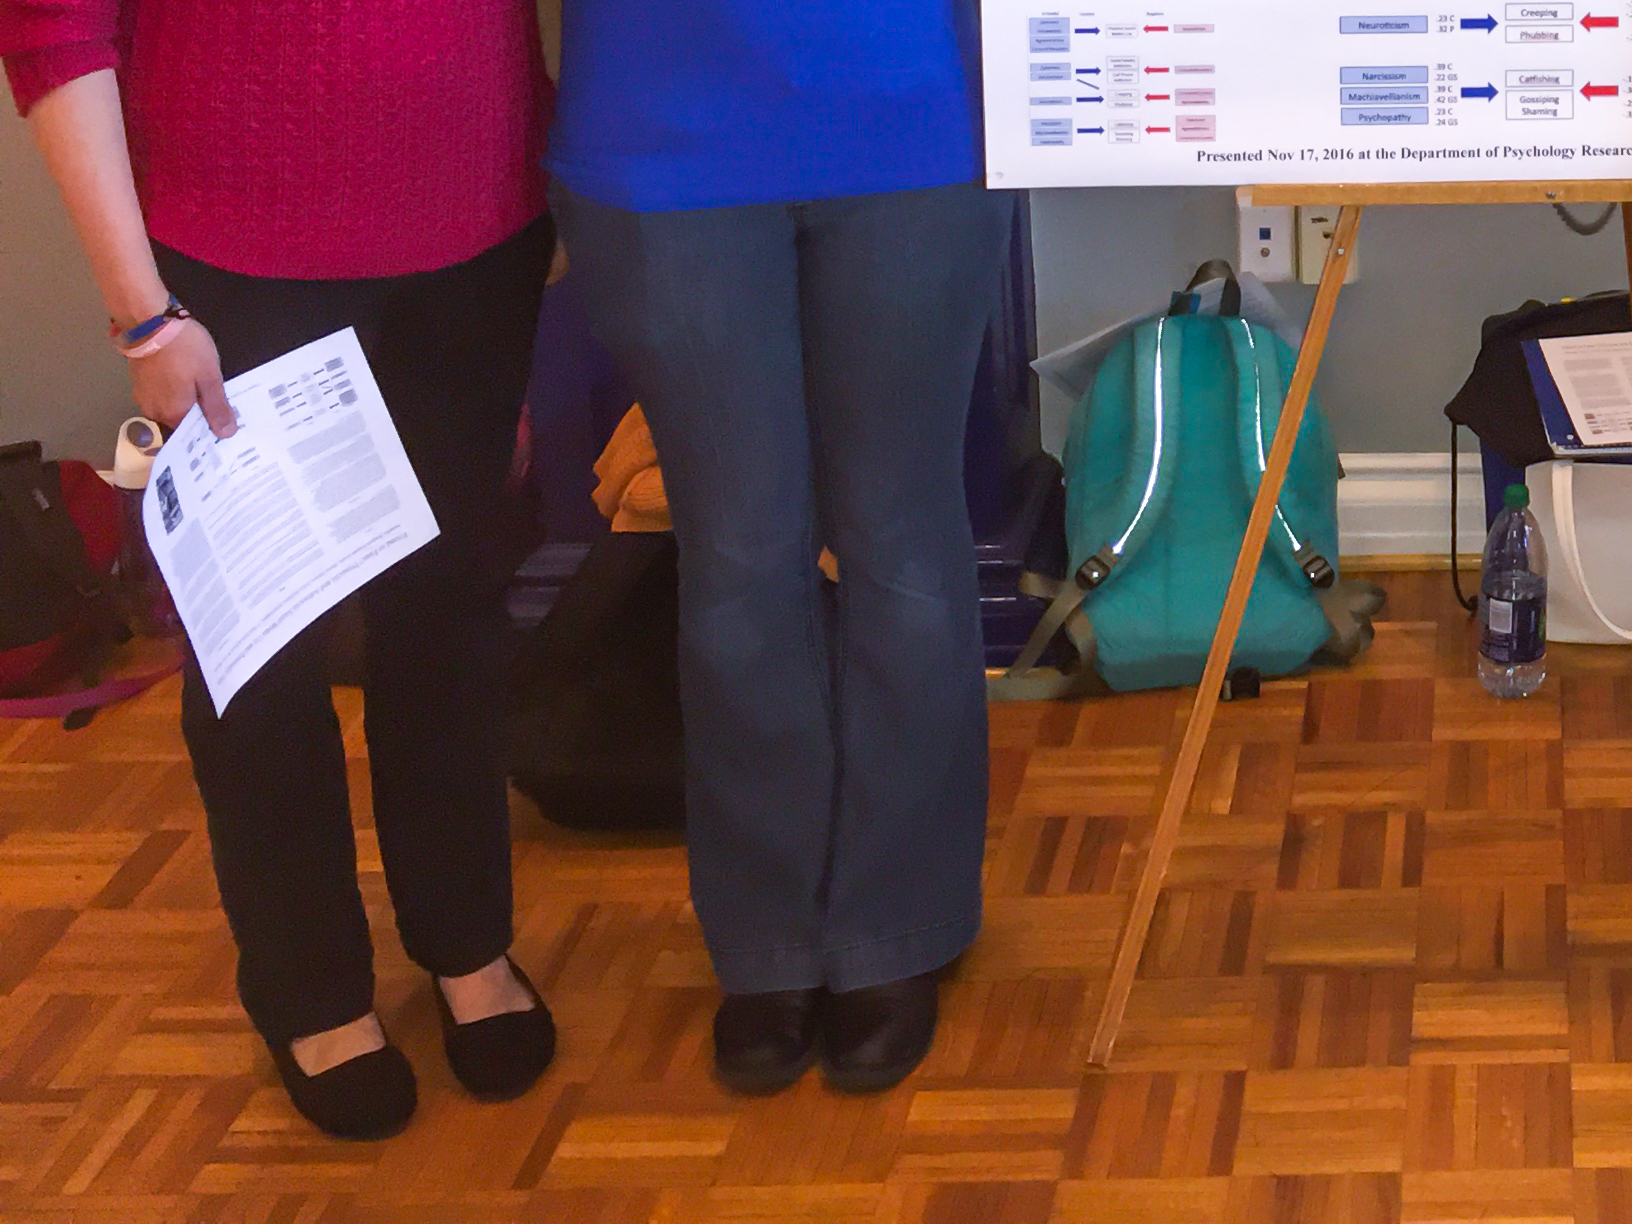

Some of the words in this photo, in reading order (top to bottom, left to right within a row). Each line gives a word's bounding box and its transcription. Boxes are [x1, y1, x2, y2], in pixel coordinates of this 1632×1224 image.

[1197, 149, 1262, 162] Presented
[1267, 148, 1294, 161] Nov
[1300, 148, 1318, 162] 17,
[1322, 147, 1354, 160] 2016
[1358, 149, 1370, 160] at
[1375, 147, 1396, 159] the
[1401, 146, 1480, 162] Department
[1485, 145, 1500, 157] of
[1503, 144, 1576, 160] Psychology
